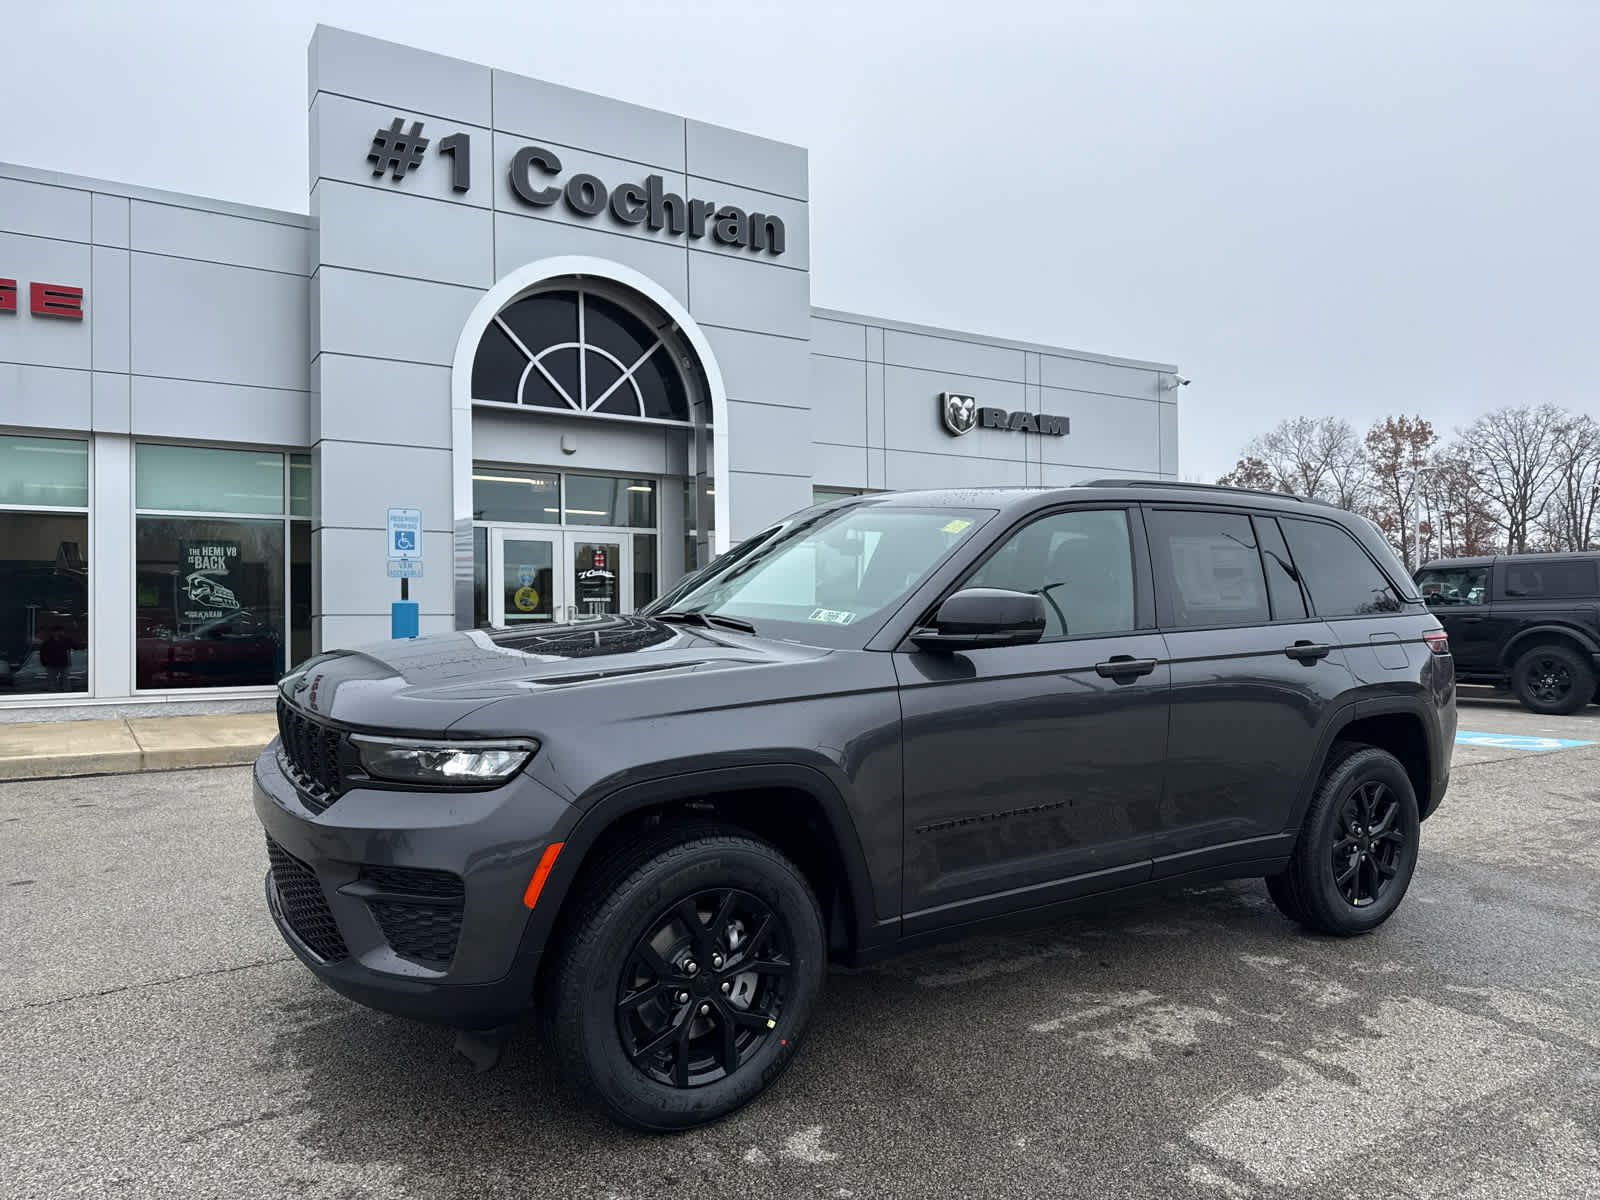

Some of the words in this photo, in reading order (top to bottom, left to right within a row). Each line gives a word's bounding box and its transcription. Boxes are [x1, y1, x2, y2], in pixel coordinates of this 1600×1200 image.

[367, 117, 470, 192] #1
[509, 146, 786, 255] Cochran
[977, 407, 1070, 436] RAM
[189, 548, 200, 556] THE
[202, 546, 224, 556] HEMI
[226, 546, 237, 557] V8
[195, 556, 226, 569] BACK
